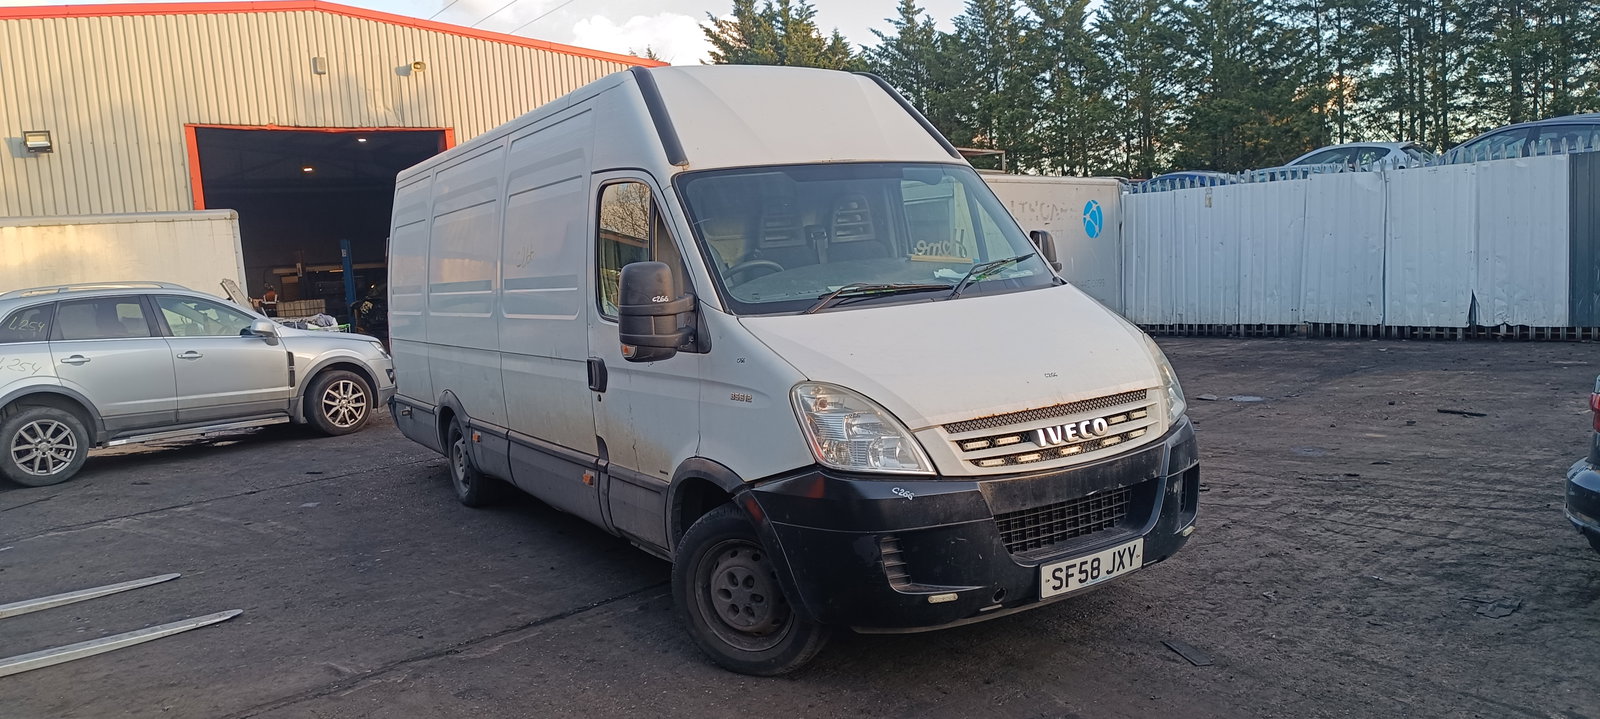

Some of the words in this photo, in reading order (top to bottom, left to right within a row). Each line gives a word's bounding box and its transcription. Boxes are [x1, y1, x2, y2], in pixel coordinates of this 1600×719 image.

[1036, 417, 1109, 448] IVECO
[891, 486, 915, 501] C266
[1051, 557, 1101, 591] SF58
[1105, 544, 1137, 575] JXY
